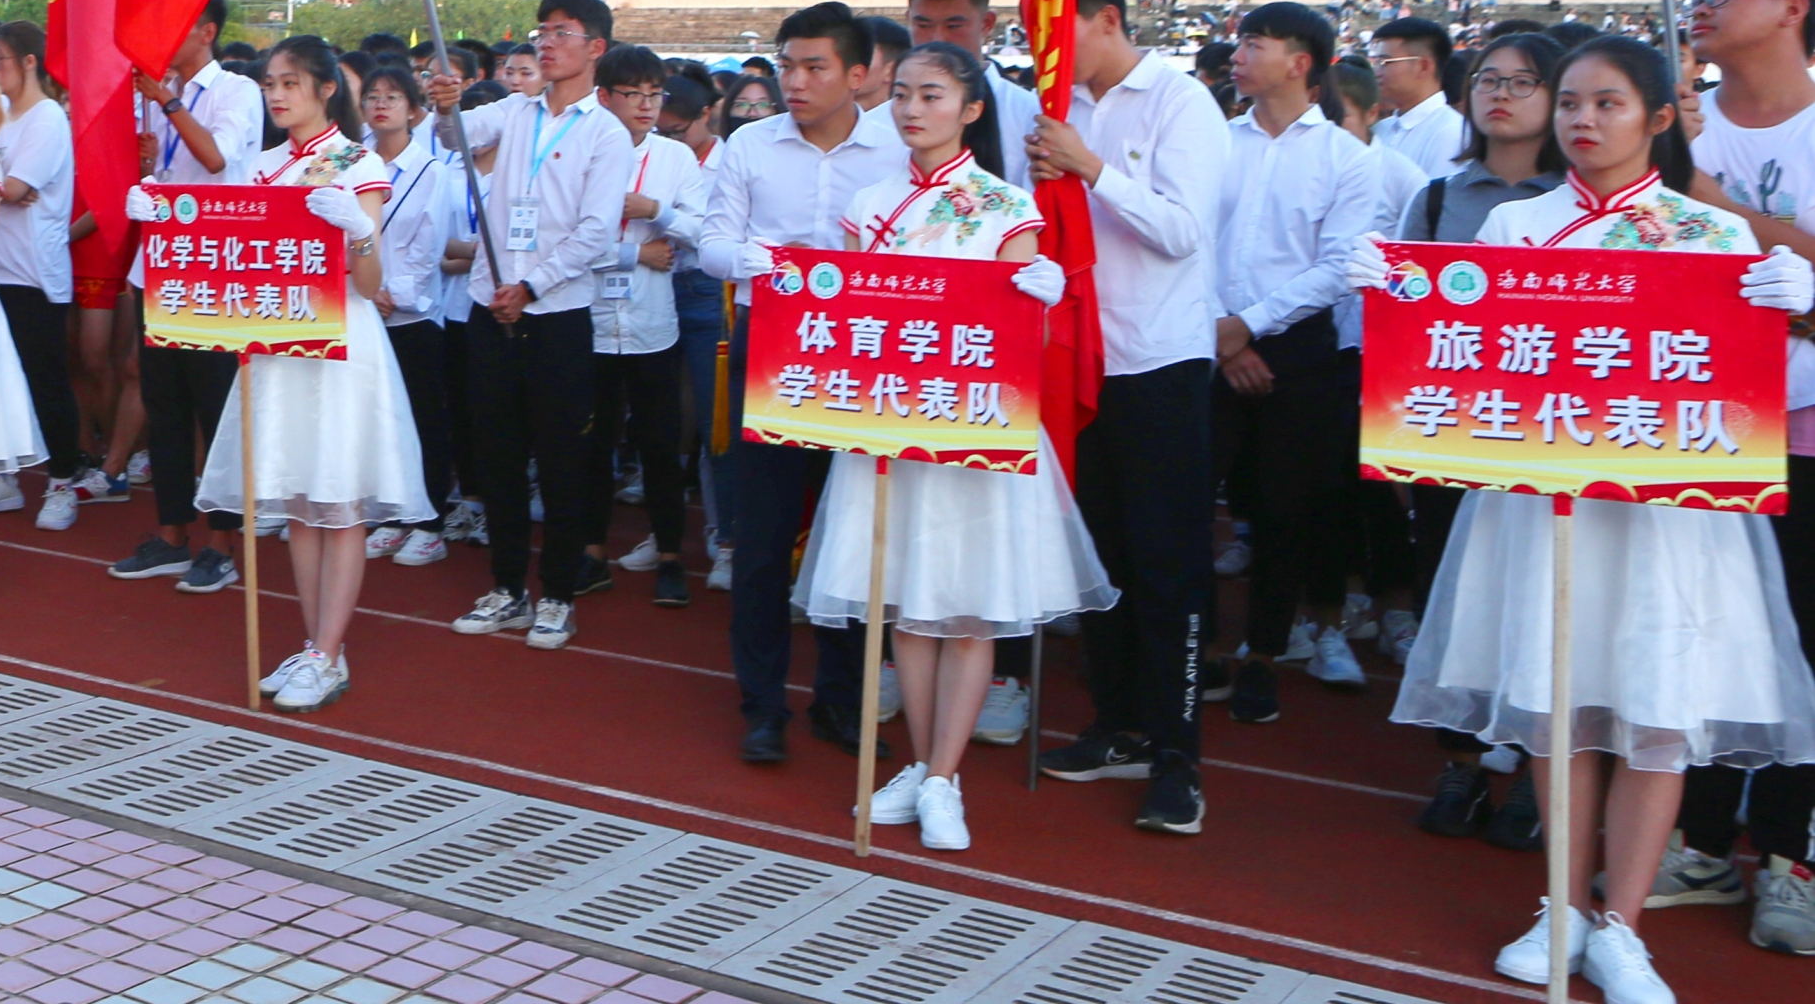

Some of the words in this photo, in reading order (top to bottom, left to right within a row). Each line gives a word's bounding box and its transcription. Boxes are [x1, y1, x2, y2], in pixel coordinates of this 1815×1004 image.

[146, 234, 328, 276] 化学与化工学院
[159, 279, 318, 322] 学生代表队
[1497, 268, 1637, 294] 海南师范大学
[796, 311, 995, 368] 体育学院
[1425, 320, 1713, 382] 旅游学院
[777, 364, 1010, 427] 学生代表队
[1403, 385, 1740, 454] 学生代表队
[1183, 685, 1197, 722] ANTA
